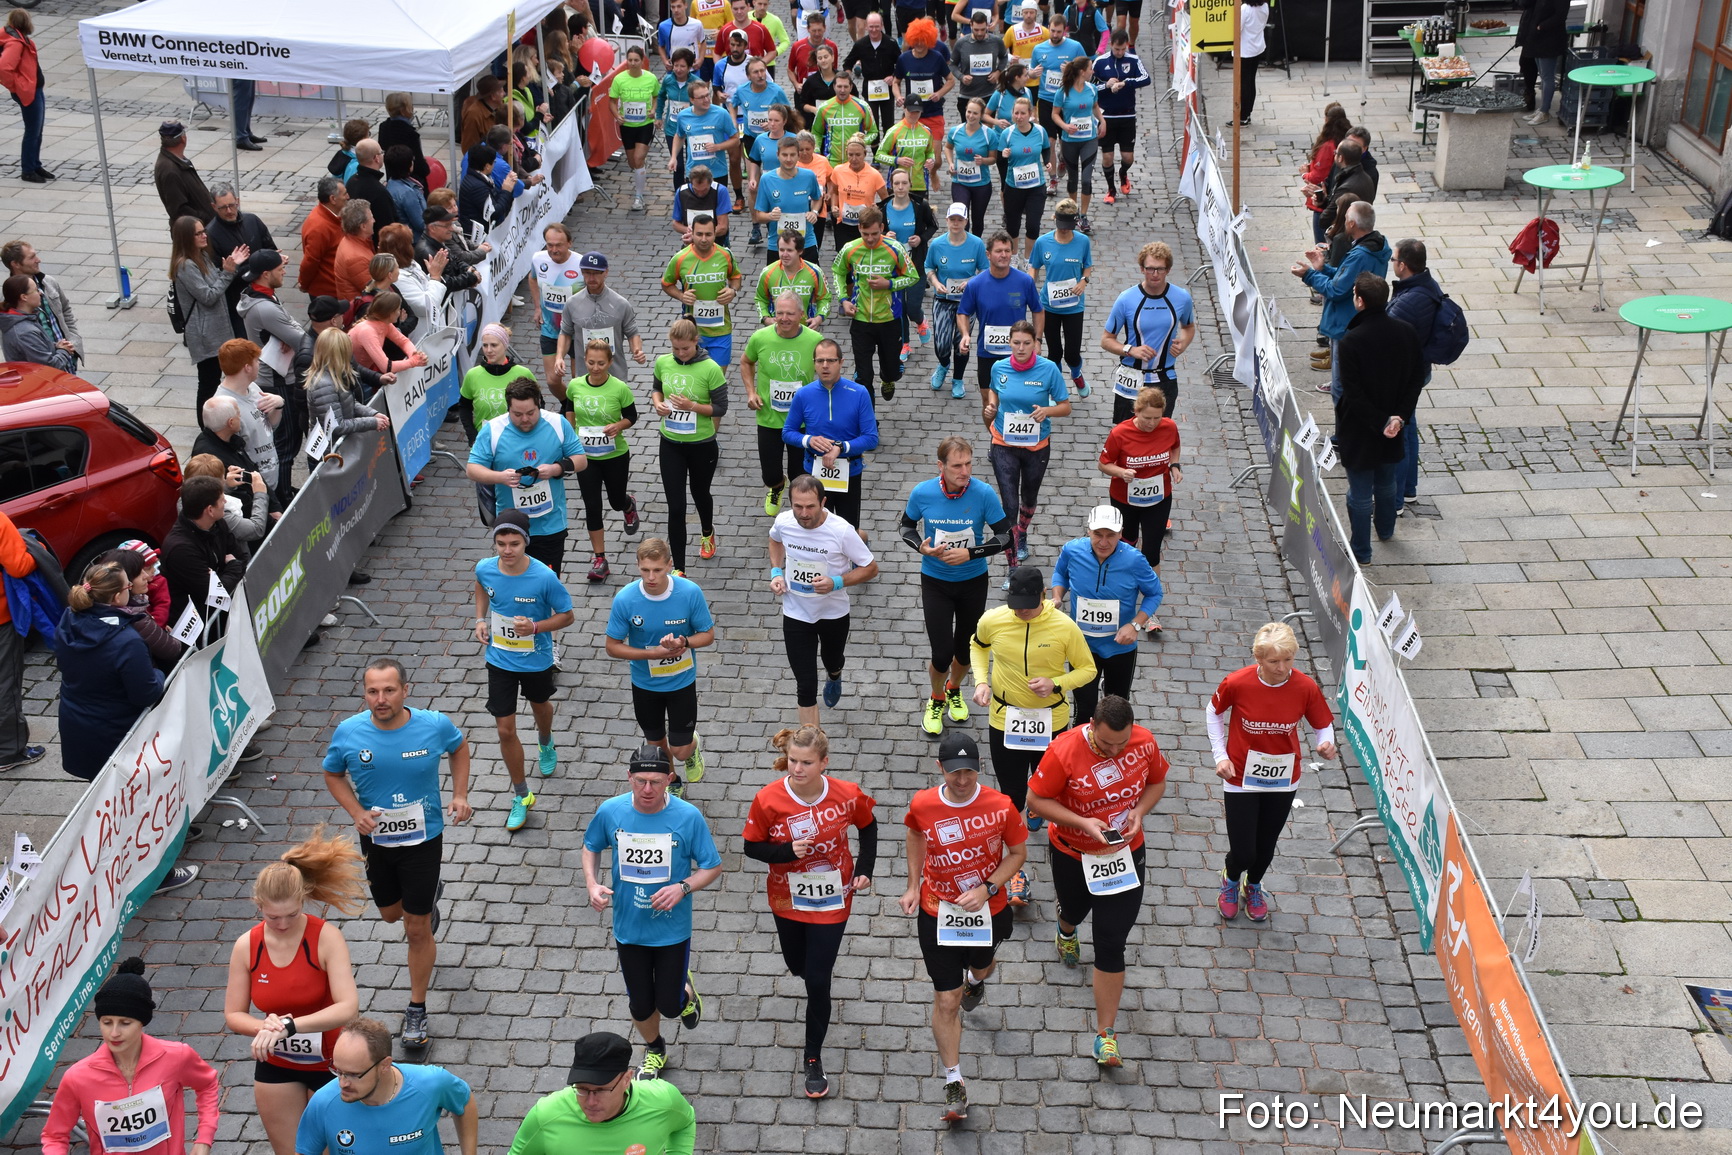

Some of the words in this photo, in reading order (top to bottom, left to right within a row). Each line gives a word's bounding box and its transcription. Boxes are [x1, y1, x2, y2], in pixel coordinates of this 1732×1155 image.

[1205, 10, 1227, 22] lauf
[98, 30, 146, 48] BMW
[152, 34, 290, 59] ConnectedDrive
[101, 49, 157, 65] Vernetzt,
[159, 56, 178, 66] um
[180, 55, 200, 67] frei
[202, 58, 217, 68] zu
[219, 58, 248, 70] sein.
[974, 60, 990, 68] 2524
[918, 86, 926, 94] 35
[827, 118, 860, 126] BOCK
[1018, 172, 1036, 181] 2370
[845, 210, 859, 219] 200
[784, 221, 800, 230] 283
[686, 274, 726, 283] BOCK
[546, 292, 567, 302] 2791
[772, 287, 811, 296] BOCK
[698, 308, 719, 317] 2781
[1118, 374, 1138, 388] 2701
[668, 411, 691, 421] 2777
[1009, 422, 1034, 434] 2447
[310, 435, 322, 454] swn
[583, 436, 609, 446] 2770
[1126, 452, 1170, 462] FACKELMANN
[820, 468, 840, 478] 302
[1133, 485, 1159, 496] 2470
[519, 492, 547, 508] 2108
[928, 518, 974, 526] www.hasit.de
[787, 542, 828, 555] www.hasit.de
[254, 550, 304, 644] BOCK
[1082, 609, 1112, 623] 2199
[181, 616, 196, 638] swn
[500, 626, 520, 638] 15
[1402, 631, 1418, 653] swn
[1011, 720, 1045, 734] 2130
[1020, 736, 1035, 744] Achim
[402, 749, 428, 758] BOCK
[1118, 742, 1155, 770] raum
[1252, 764, 1287, 778] 2507
[392, 793, 408, 803] 18.
[378, 819, 417, 834] 2095
[105, 759, 187, 909] BESSER
[968, 828, 996, 840] schenken
[626, 848, 663, 864] 2323
[1090, 858, 1126, 878] 2505
[1102, 879, 1123, 888] Andreas
[634, 886, 647, 898] 18.
[797, 884, 834, 897] 2118
[945, 915, 984, 927] 2506
[44, 977, 96, 1061] Service-Line:
[1488, 1002, 1498, 1018] für
[1494, 1018, 1503, 1032] die
[1498, 998, 1522, 1046] Neumarkts
[107, 1107, 156, 1132] 2450
[125, 1134, 147, 1143] Nicole
[390, 1130, 423, 1144] BOCK
